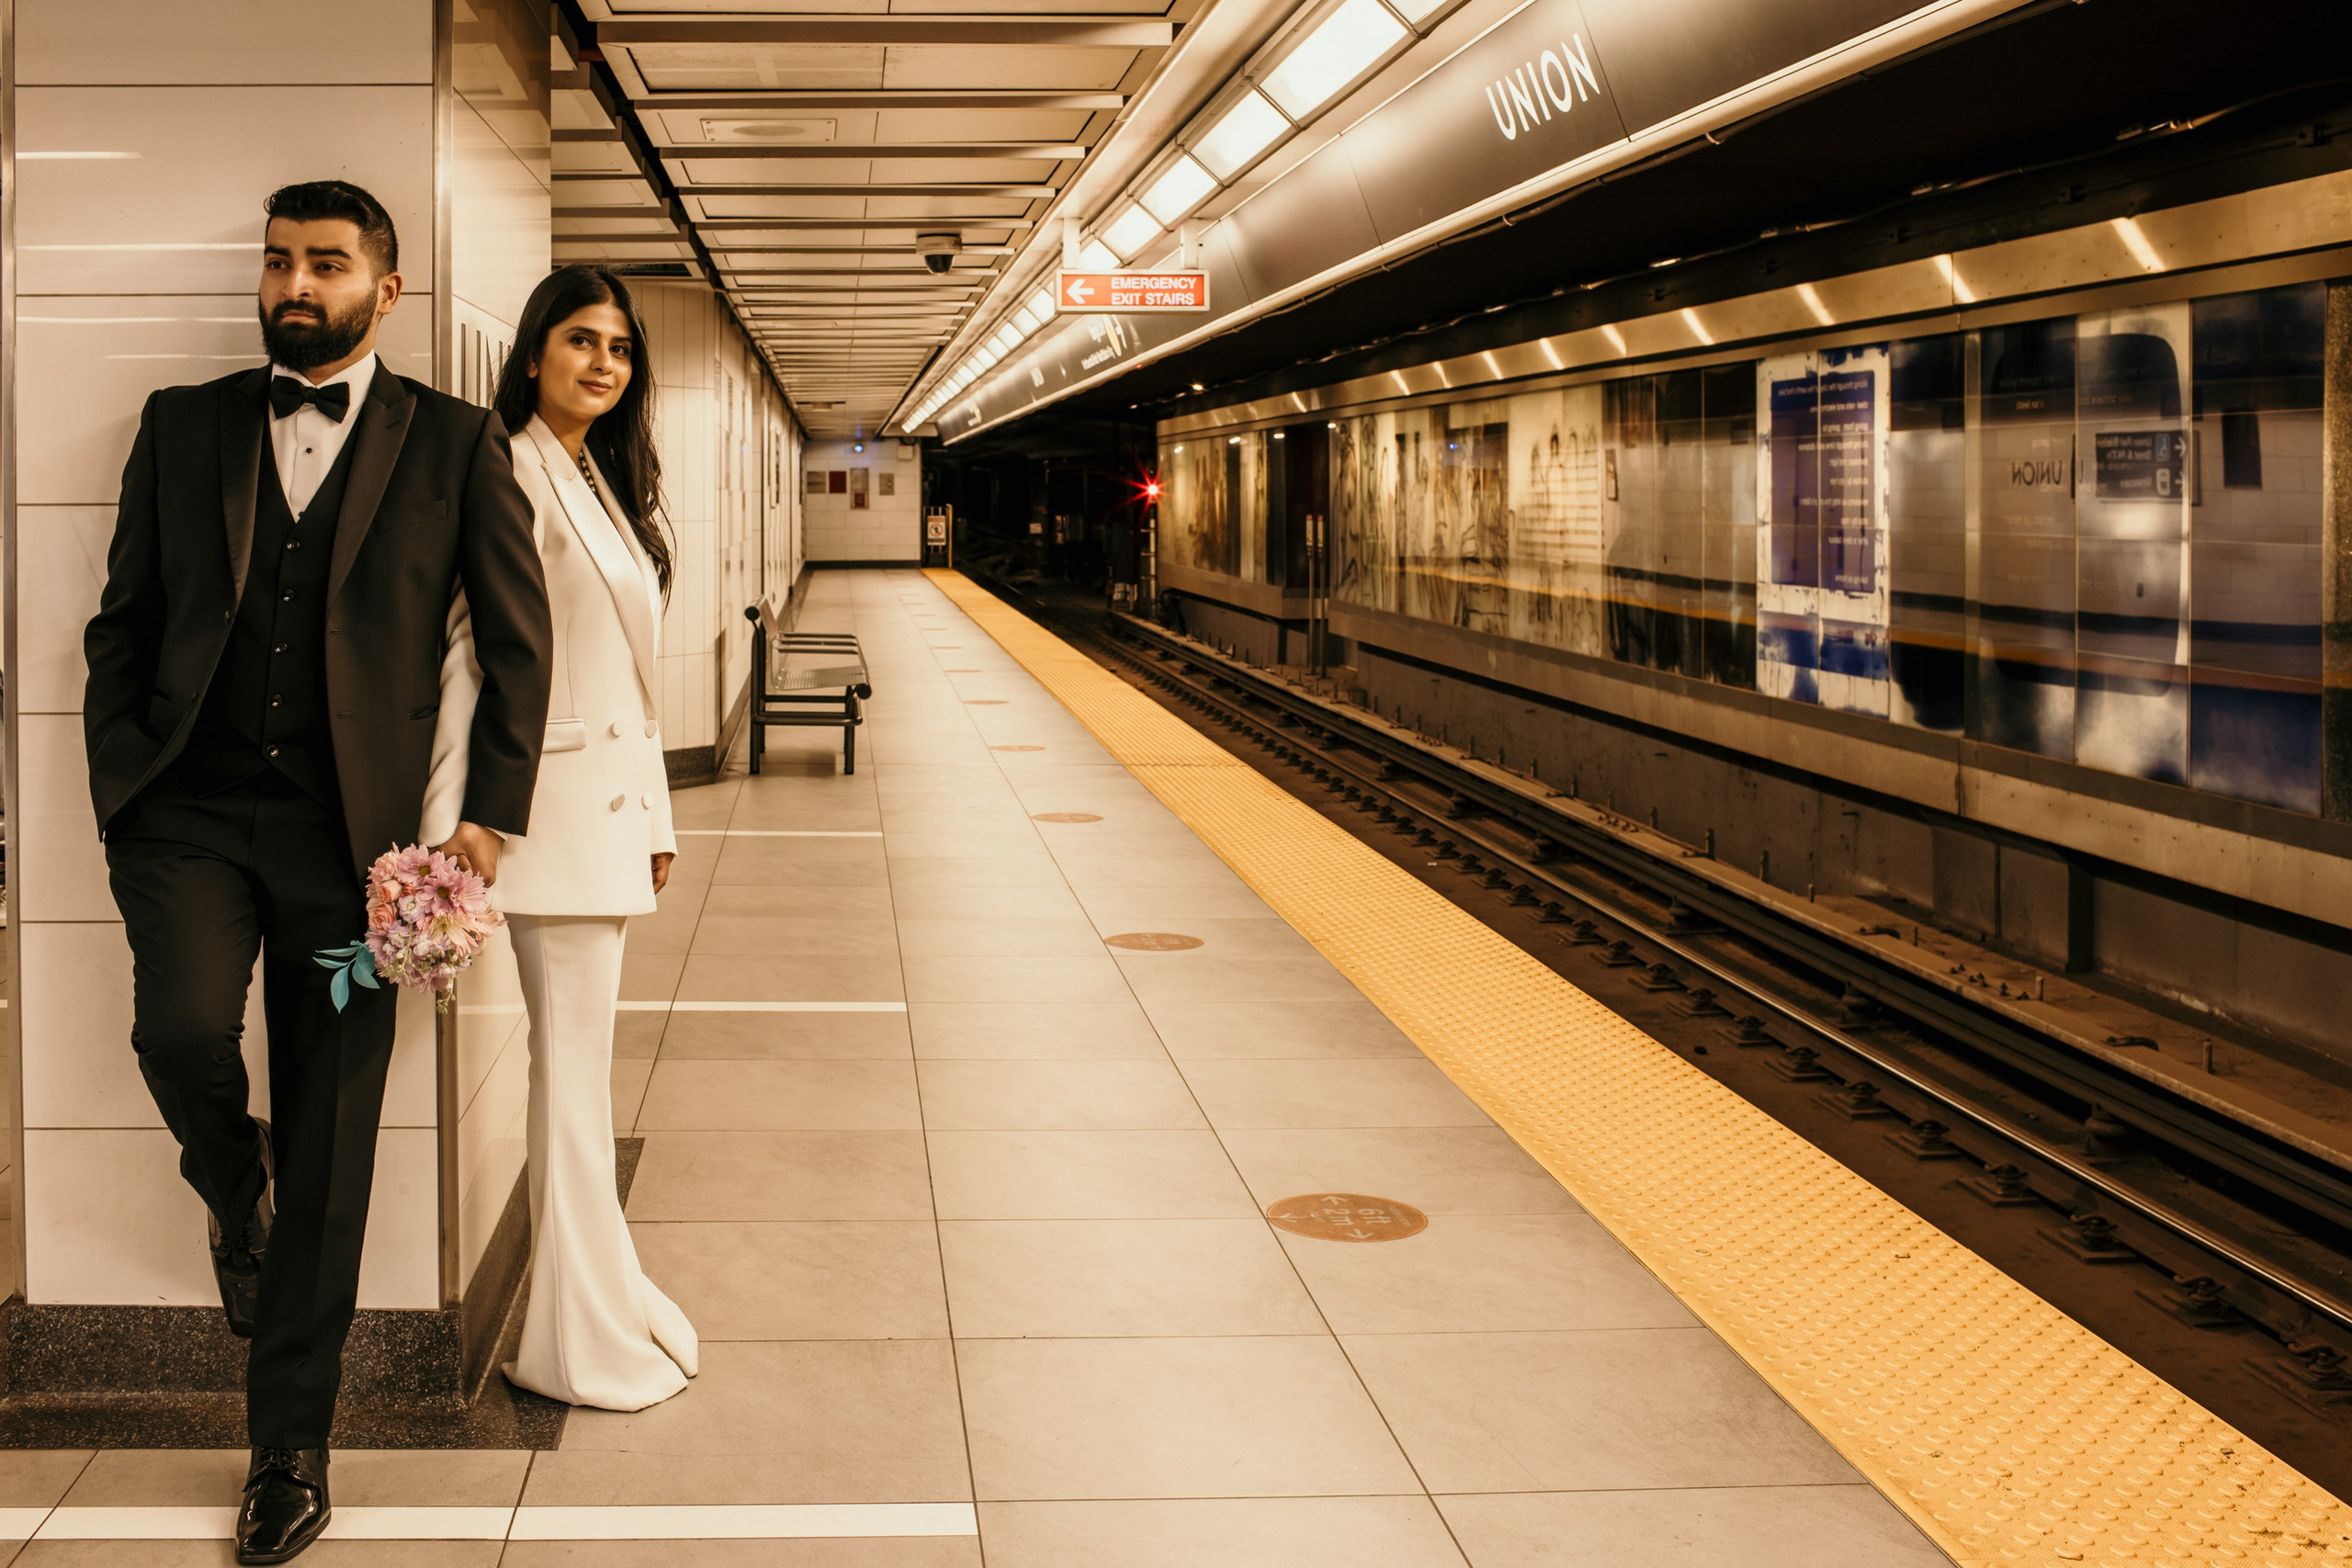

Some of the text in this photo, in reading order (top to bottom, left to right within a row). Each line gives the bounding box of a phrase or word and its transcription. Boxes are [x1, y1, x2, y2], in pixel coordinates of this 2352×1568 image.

[1485, 32, 1600, 141] UNION
[1111, 277, 1196, 289] EMERGENCY
[1111, 292, 1195, 305] EXIT STAIRS
[1323, 1208, 1354, 1226] 2m
[1357, 1208, 1392, 1224] 6ft
